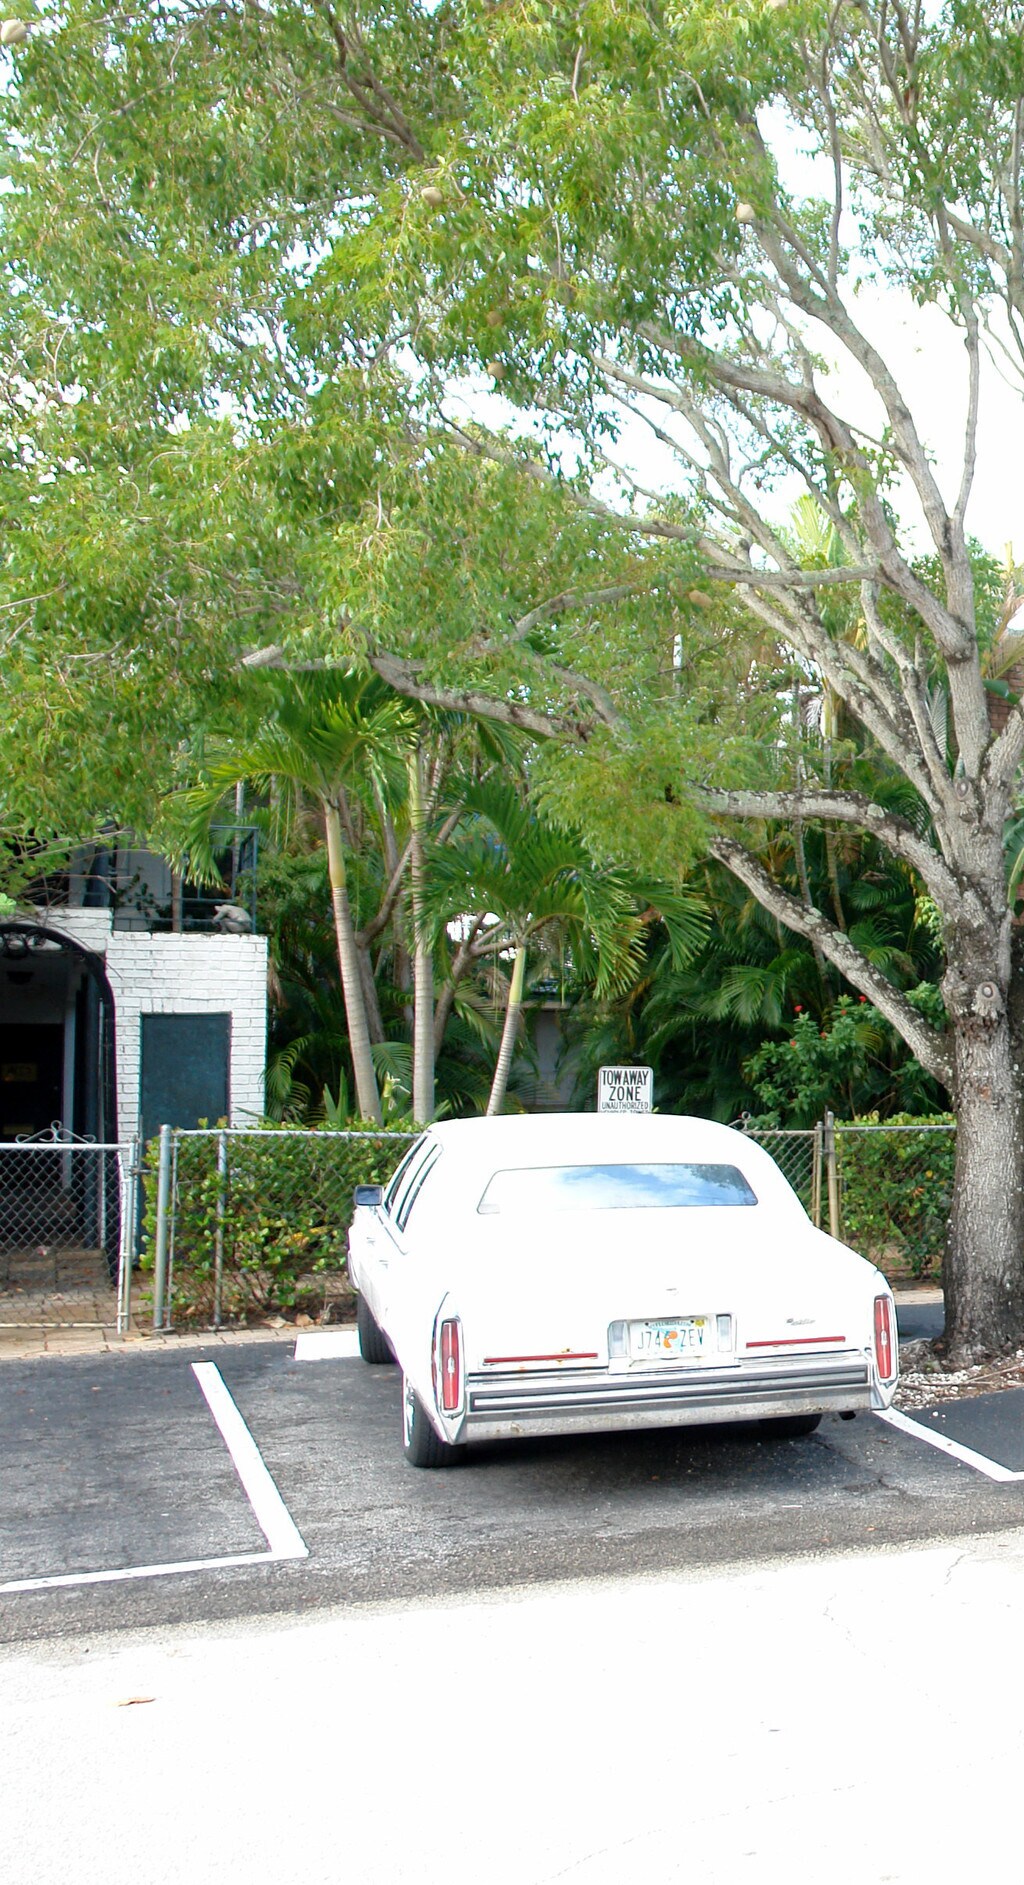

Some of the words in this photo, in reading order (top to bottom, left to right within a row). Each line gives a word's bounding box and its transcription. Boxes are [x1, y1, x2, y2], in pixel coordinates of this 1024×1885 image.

[609, 1086, 641, 1101] ZONE
[602, 1102, 649, 1110] UNAUTHORIZED
[680, 1329, 703, 1347] ZEV
